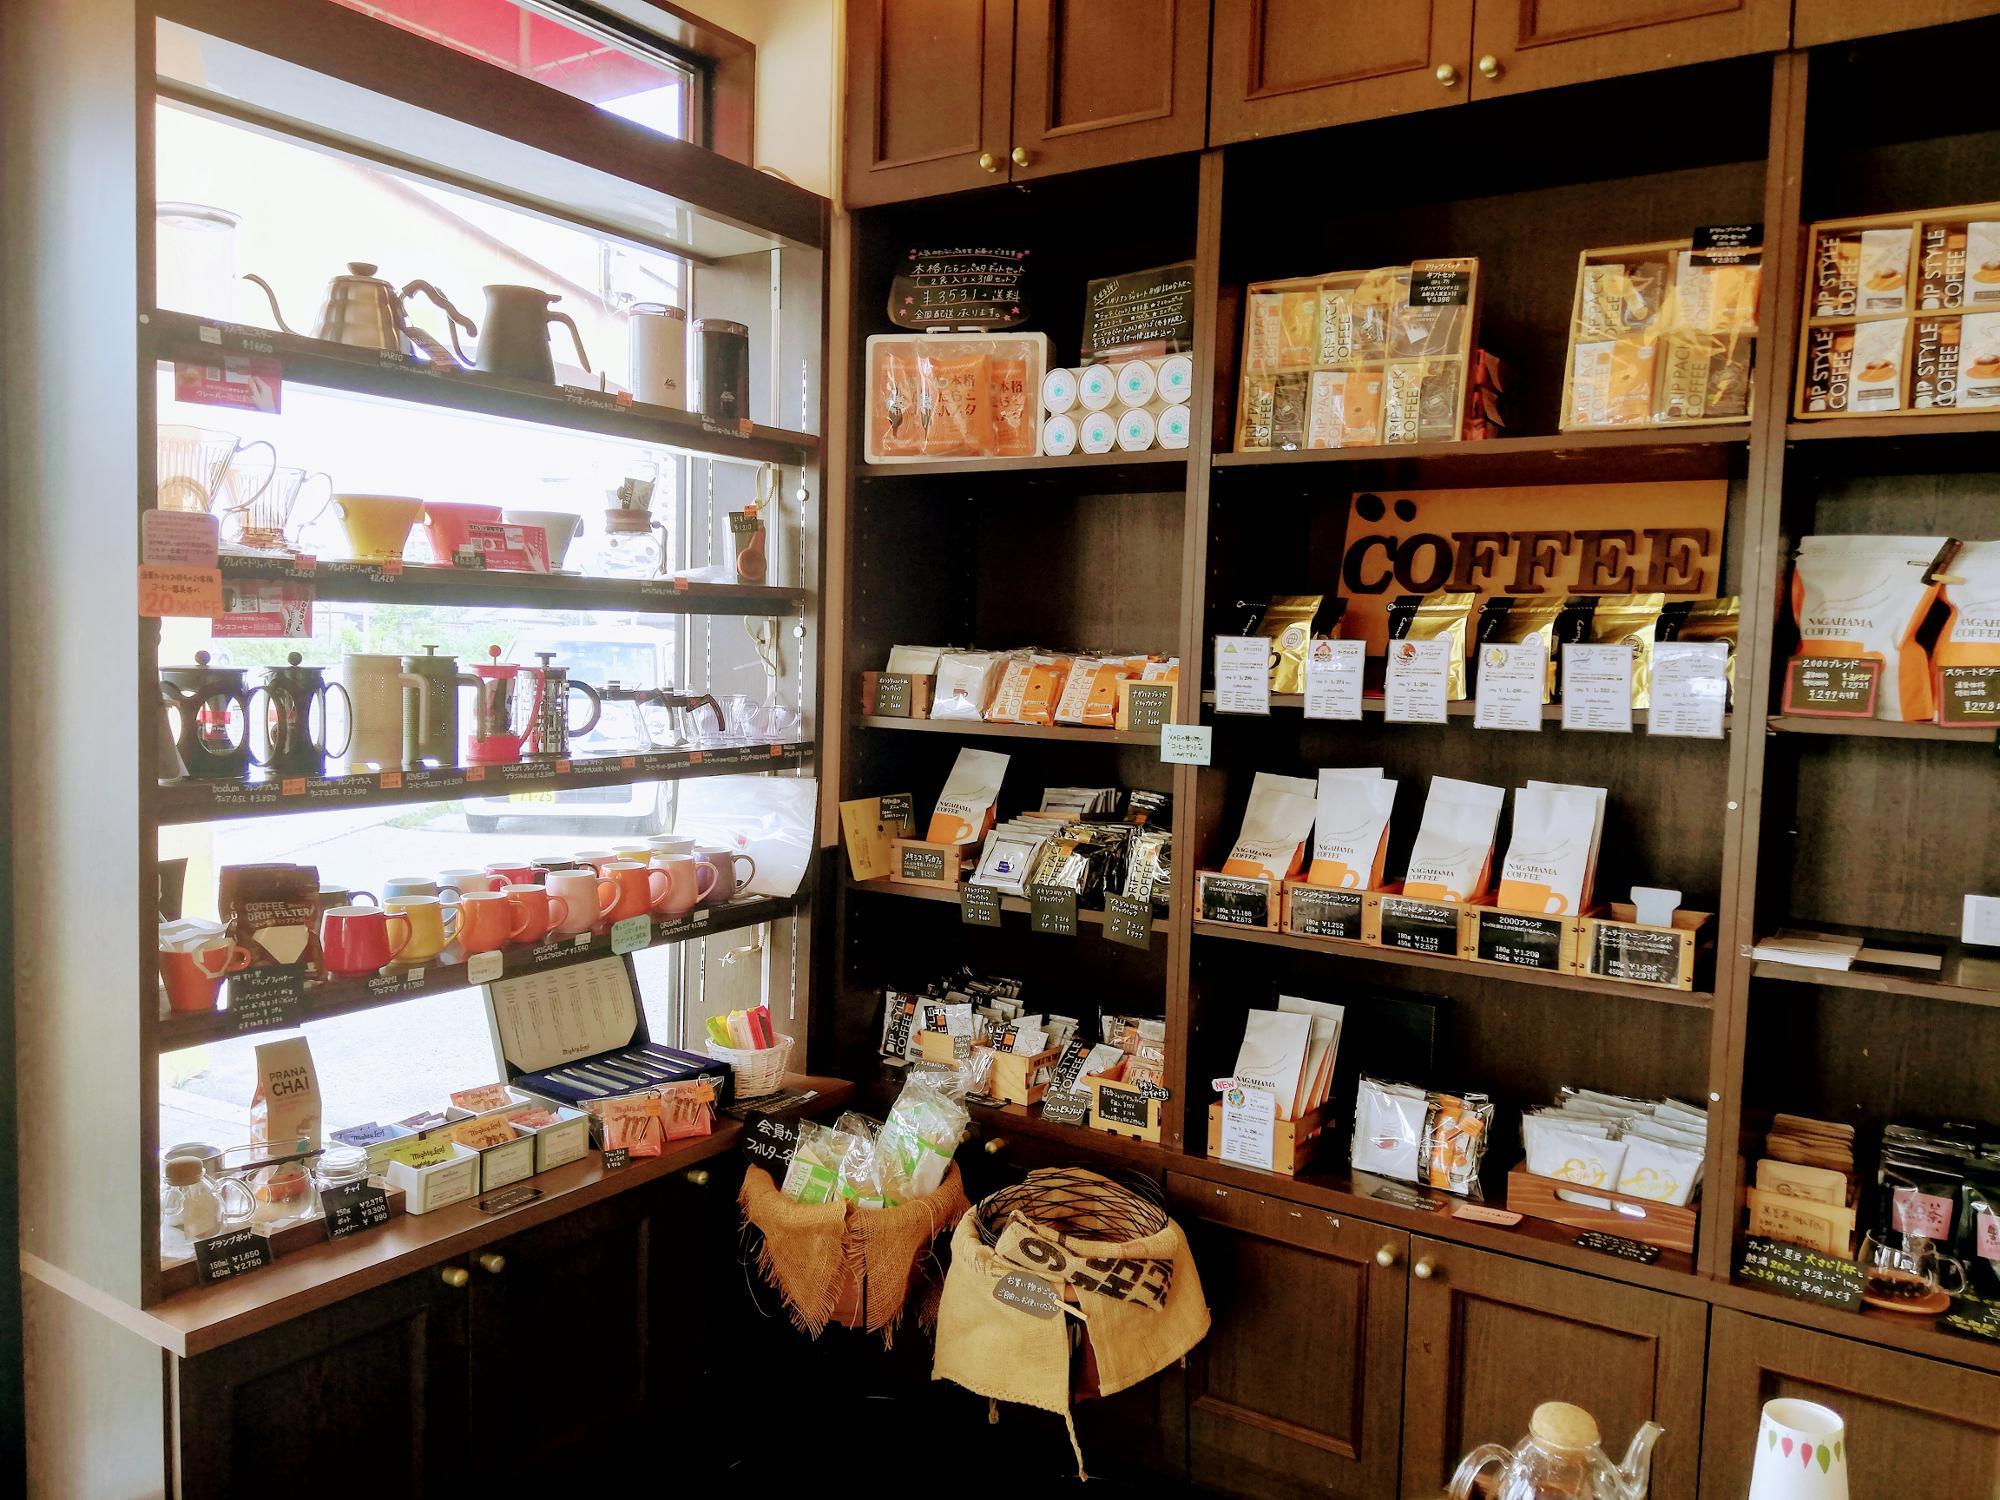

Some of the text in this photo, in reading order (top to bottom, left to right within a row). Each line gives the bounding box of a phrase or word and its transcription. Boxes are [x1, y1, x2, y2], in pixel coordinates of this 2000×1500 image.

[1821, 238, 1840, 287] STYLE
[1922, 229, 1945, 310] DIP STYLE
[1944, 250, 1965, 308] COFFEE
[1809, 329, 1833, 411] DIP STYLE
[1829, 352, 1851, 409] COFFEE
[1914, 323, 1938, 408] DIP STYLE
[1936, 346, 1958, 407] COFFEE
[1686, 363, 1707, 418] COFFEE
[1403, 390, 1419, 443] COFFEE
[1342, 527, 1710, 595] COFFEE
[1805, 628, 1851, 637] COFFEE
[1808, 617, 1873, 629] NAGAHAMA
[1009, 677, 1028, 716] COFFEE
[1072, 678, 1094, 718] COFFEE
[1507, 871, 1542, 881] COFFEE
[1509, 863, 1558, 876] NAGAHAMA
[245, 901, 286, 911] COFFEE
[248, 908, 311, 922] DRIP FILTER
[533, 943, 558, 956] ORIGAMI
[368, 975, 398, 988] ORIGAMI
[886, 996, 907, 1054] DIP STYLE
[896, 1015, 914, 1056] COFFEE
[1059, 1042, 1082, 1073] STYLE
[269, 1066, 307, 1081] PRANA
[272, 1076, 309, 1097] CHAI
[1215, 1080, 1234, 1090] NEW
[1236, 1076, 1276, 1087] NAGAHAMA
[344, 1183, 360, 1195] チャイ
[374, 1213, 388, 1222] 990
